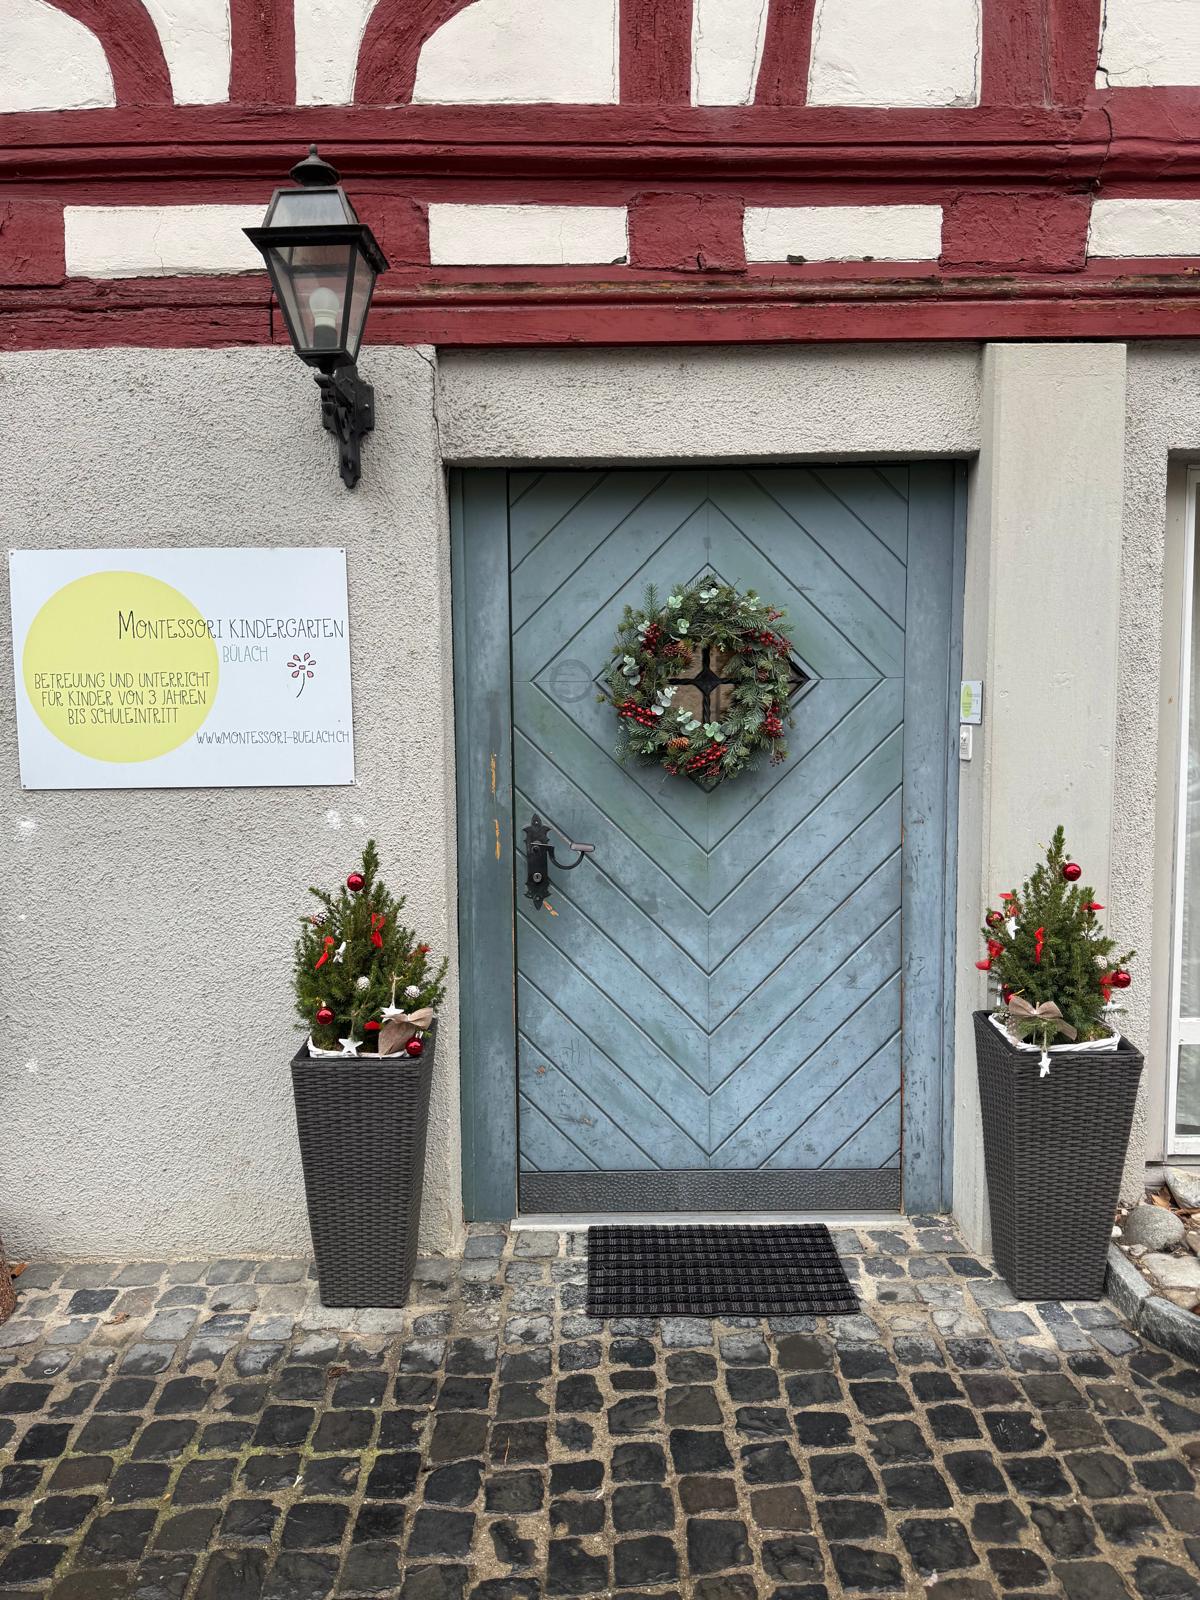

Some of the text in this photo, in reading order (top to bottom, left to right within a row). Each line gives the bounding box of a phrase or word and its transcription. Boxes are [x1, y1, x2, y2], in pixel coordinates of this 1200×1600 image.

[118, 610, 344, 640] MONTESSORI KINDERGARTEN
[222, 644, 268, 663] BÜLACH
[34, 671, 211, 690] BETREUUNG UND UNTERRICHT
[41, 689, 206, 707] FÜR KINDER VON 3 JAHREN
[67, 707, 179, 725] BIS SCHULEINTRITT
